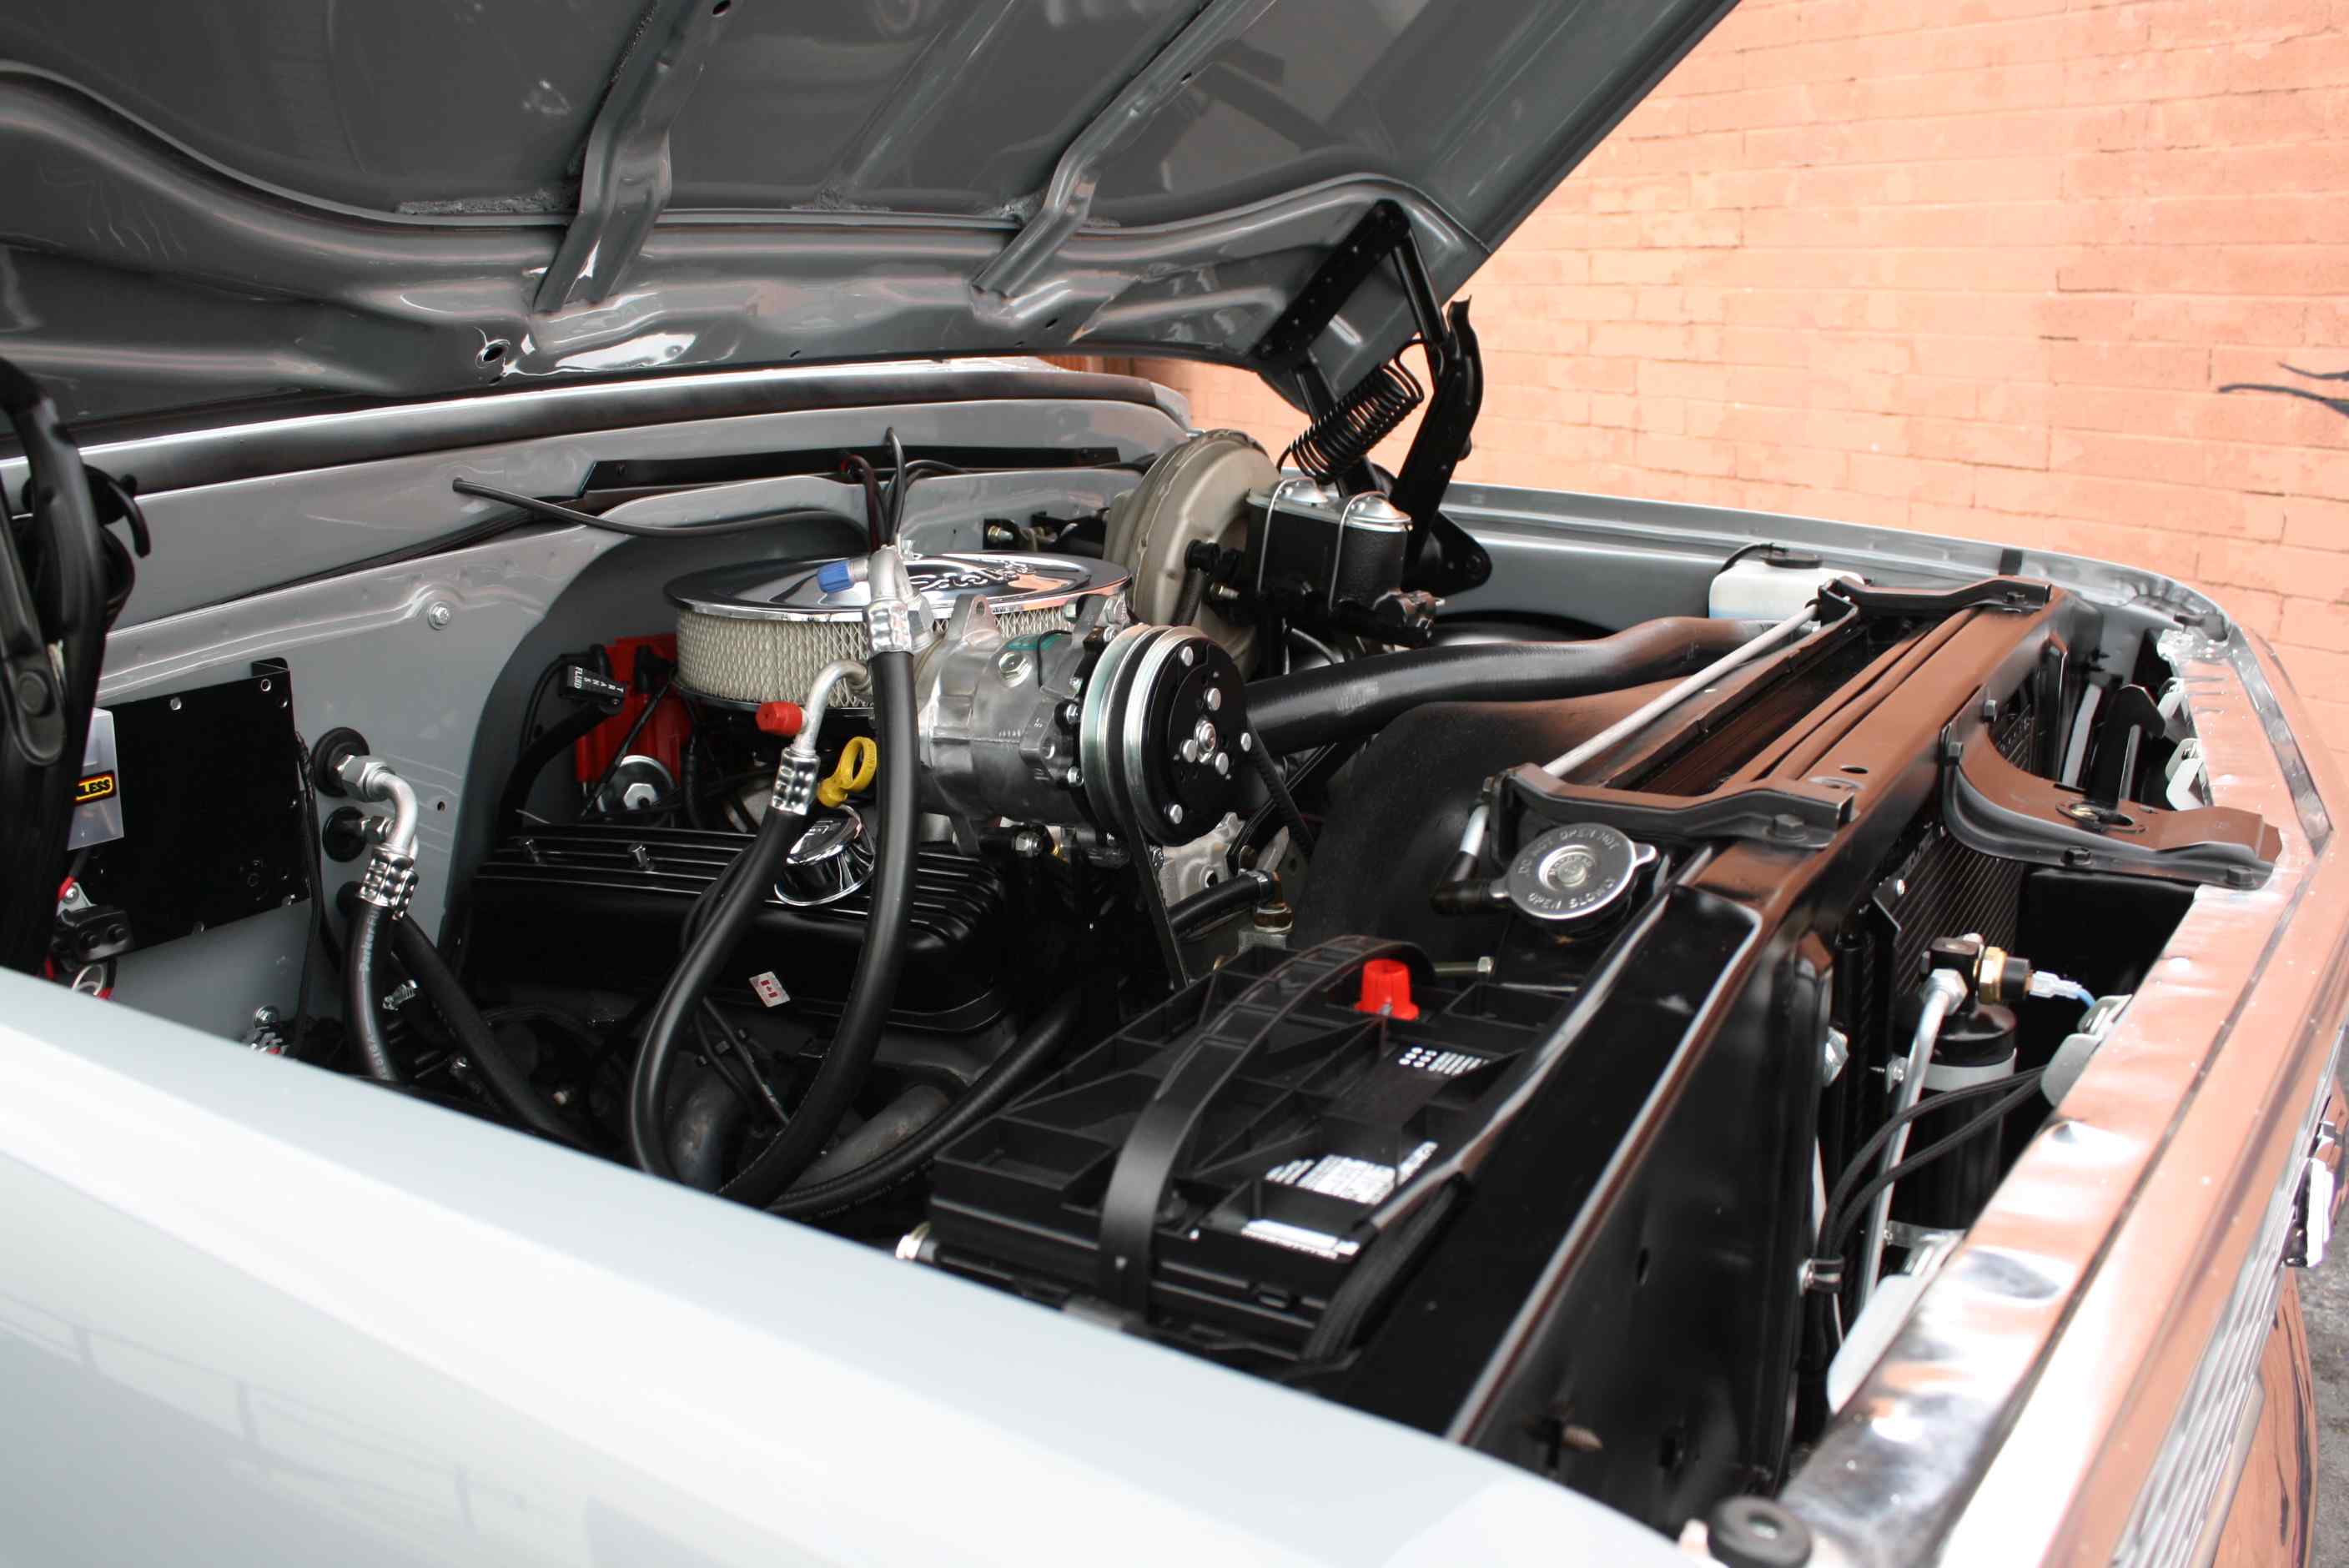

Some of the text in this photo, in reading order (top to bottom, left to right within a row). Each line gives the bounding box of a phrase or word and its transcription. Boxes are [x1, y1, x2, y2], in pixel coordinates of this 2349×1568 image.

[573, 666, 583, 689] FLUID
[583, 676, 624, 693] TRANS
[78, 776, 112, 798] LESS
[1527, 892, 1562, 910] OPEN
